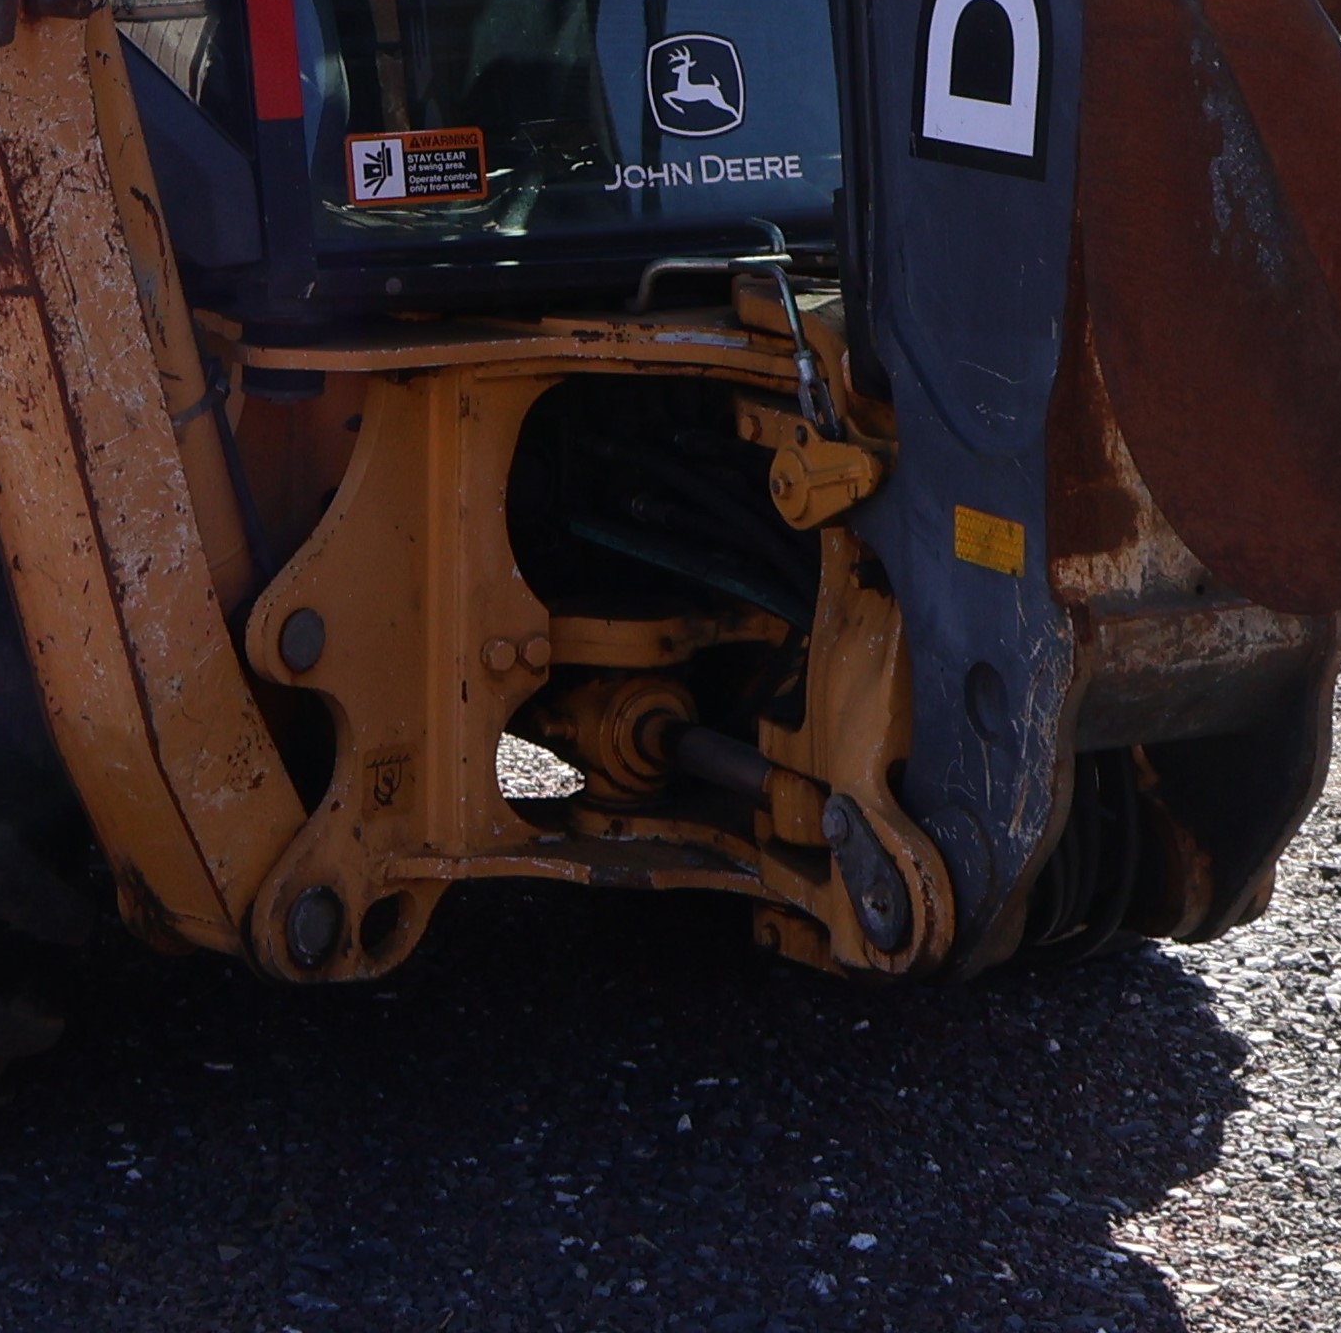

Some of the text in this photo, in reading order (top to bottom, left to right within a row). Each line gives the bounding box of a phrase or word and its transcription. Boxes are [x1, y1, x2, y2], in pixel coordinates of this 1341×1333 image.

[419, 133, 478, 147] WARNING
[407, 151, 466, 163] STAY CLEAR
[407, 161, 466, 172] of swing area.
[604, 154, 803, 191] JOHN DEERE
[408, 172, 478, 185] Operate controls
[409, 184, 428, 194] only
[429, 183, 450, 192] from
[450, 181, 471, 190] seat.
